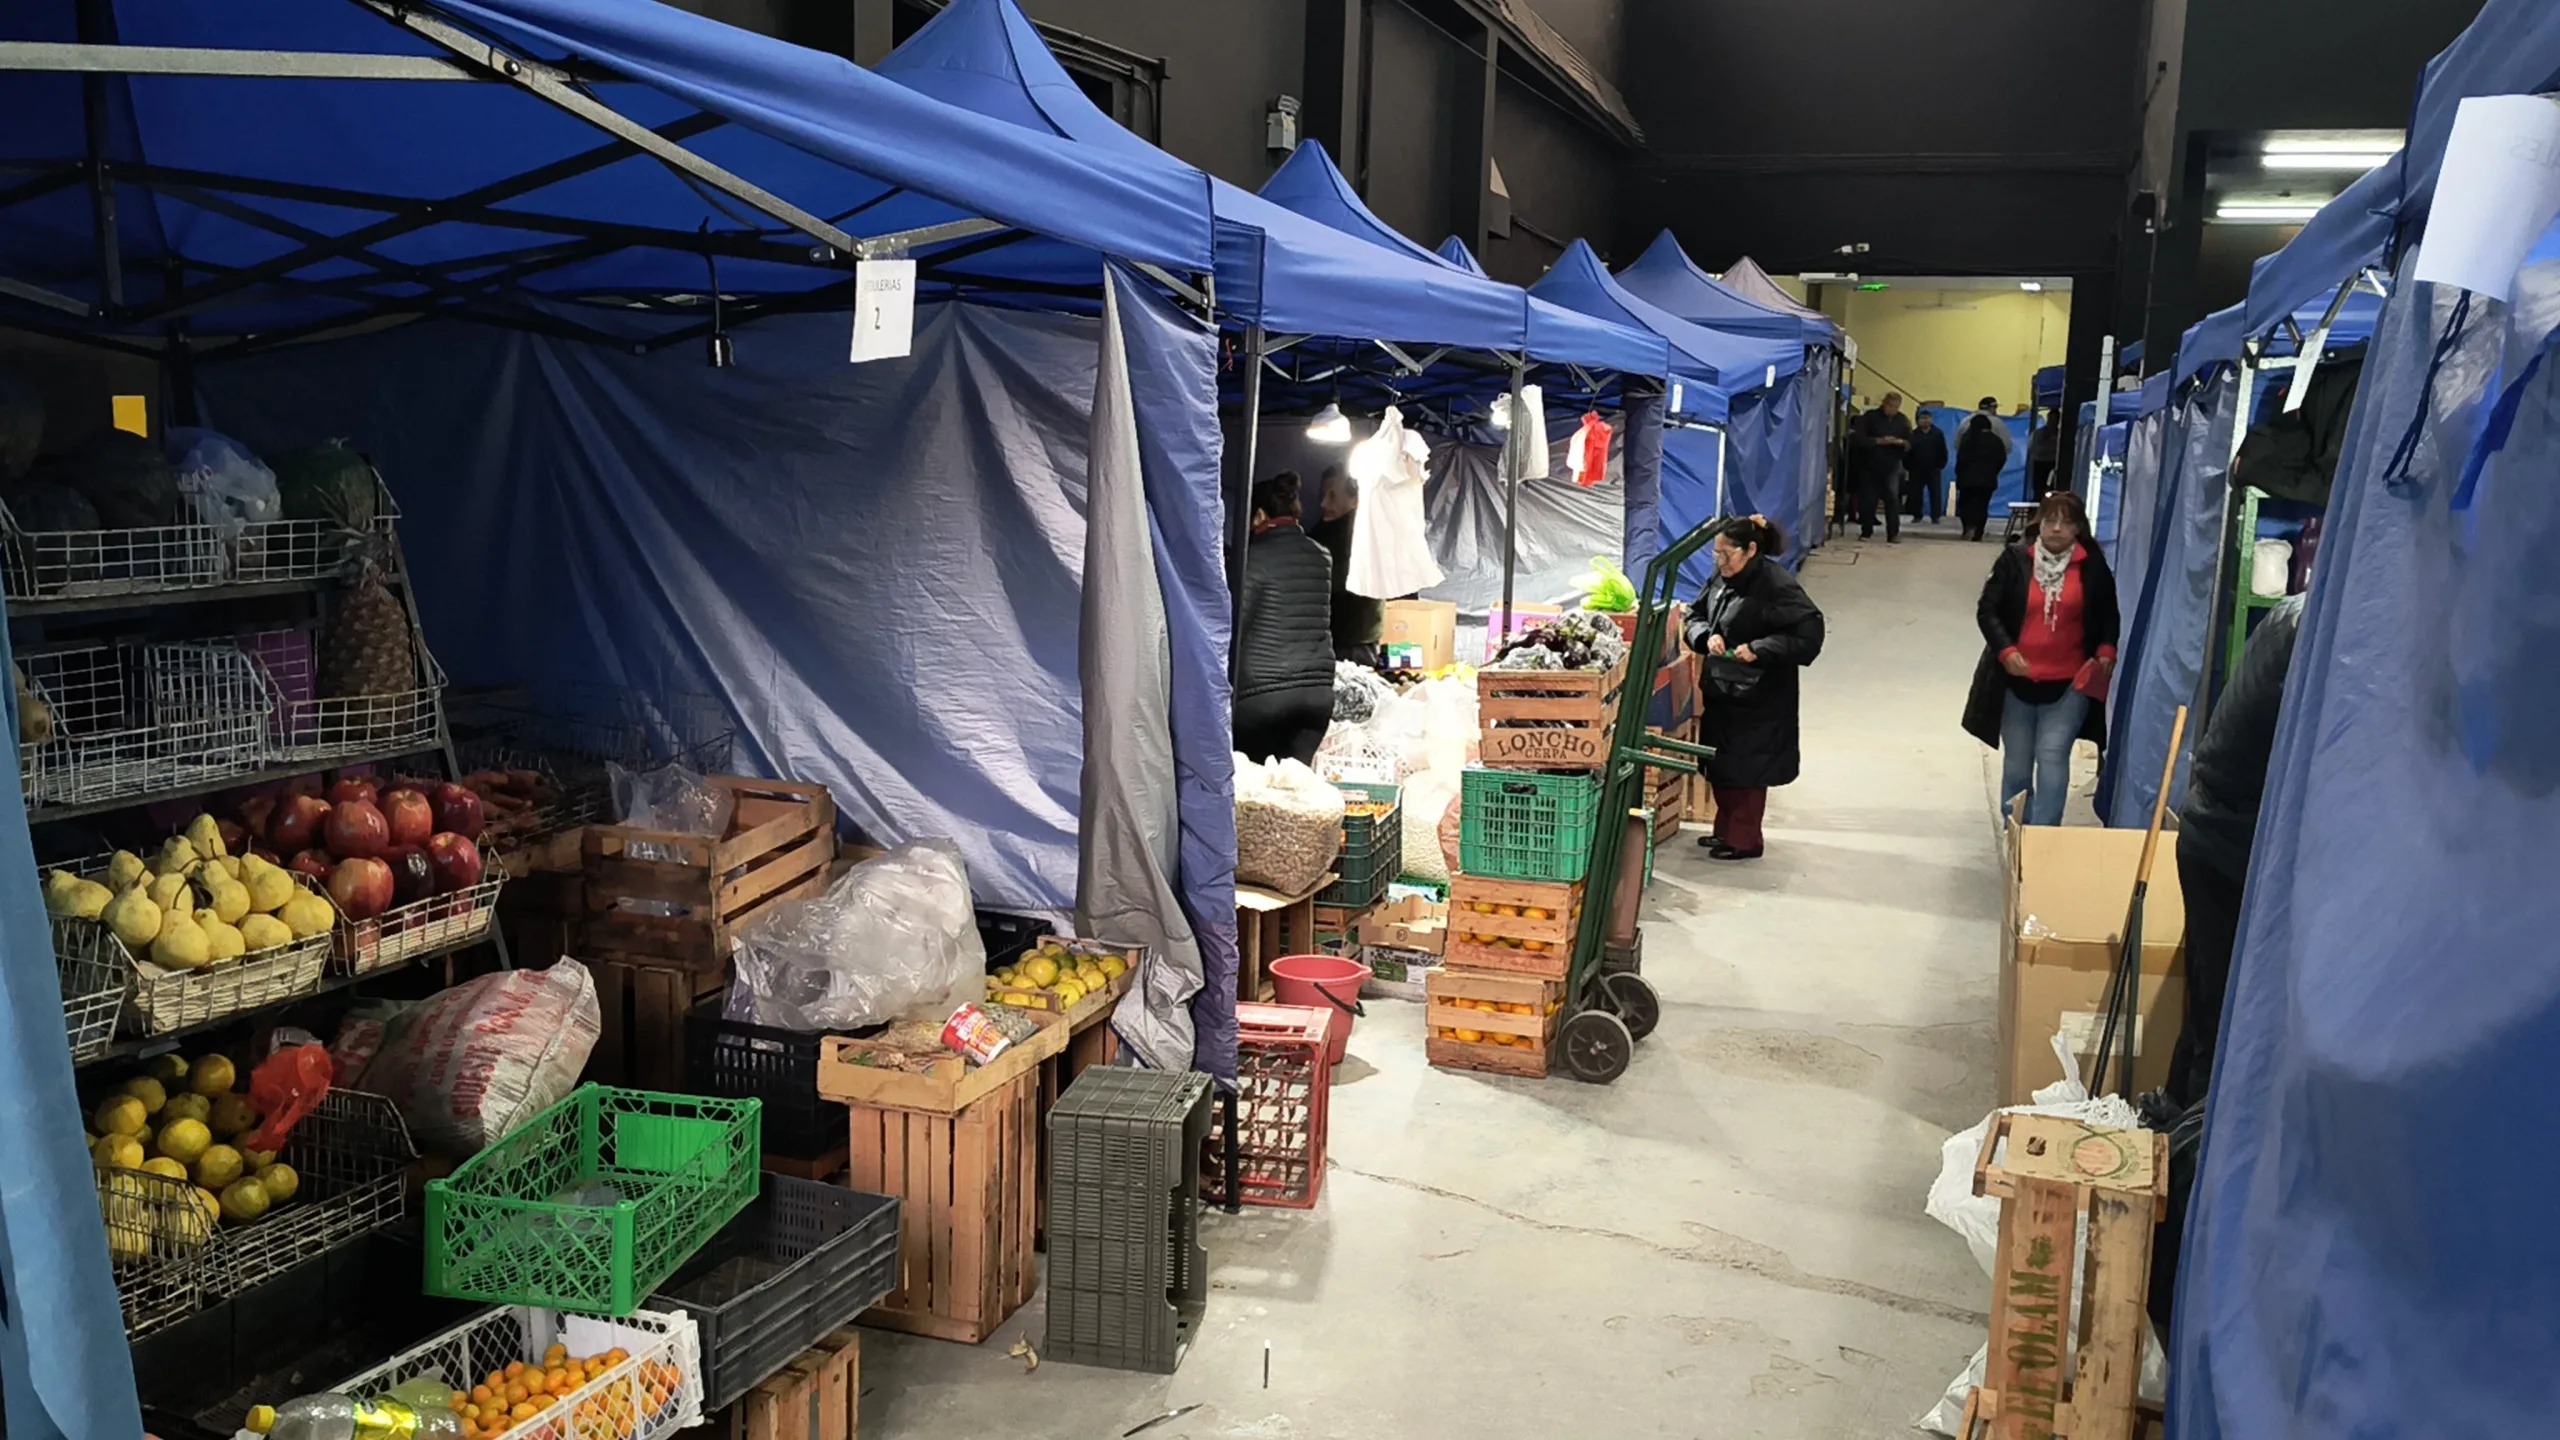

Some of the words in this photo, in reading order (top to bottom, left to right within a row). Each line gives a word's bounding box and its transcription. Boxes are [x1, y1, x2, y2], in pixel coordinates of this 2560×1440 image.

[874, 306, 881, 330] 2
[1497, 731, 1595, 757] LONCHO
[1525, 747, 1567, 759] CERPA
[451, 1043, 502, 1117] SUDESTE
